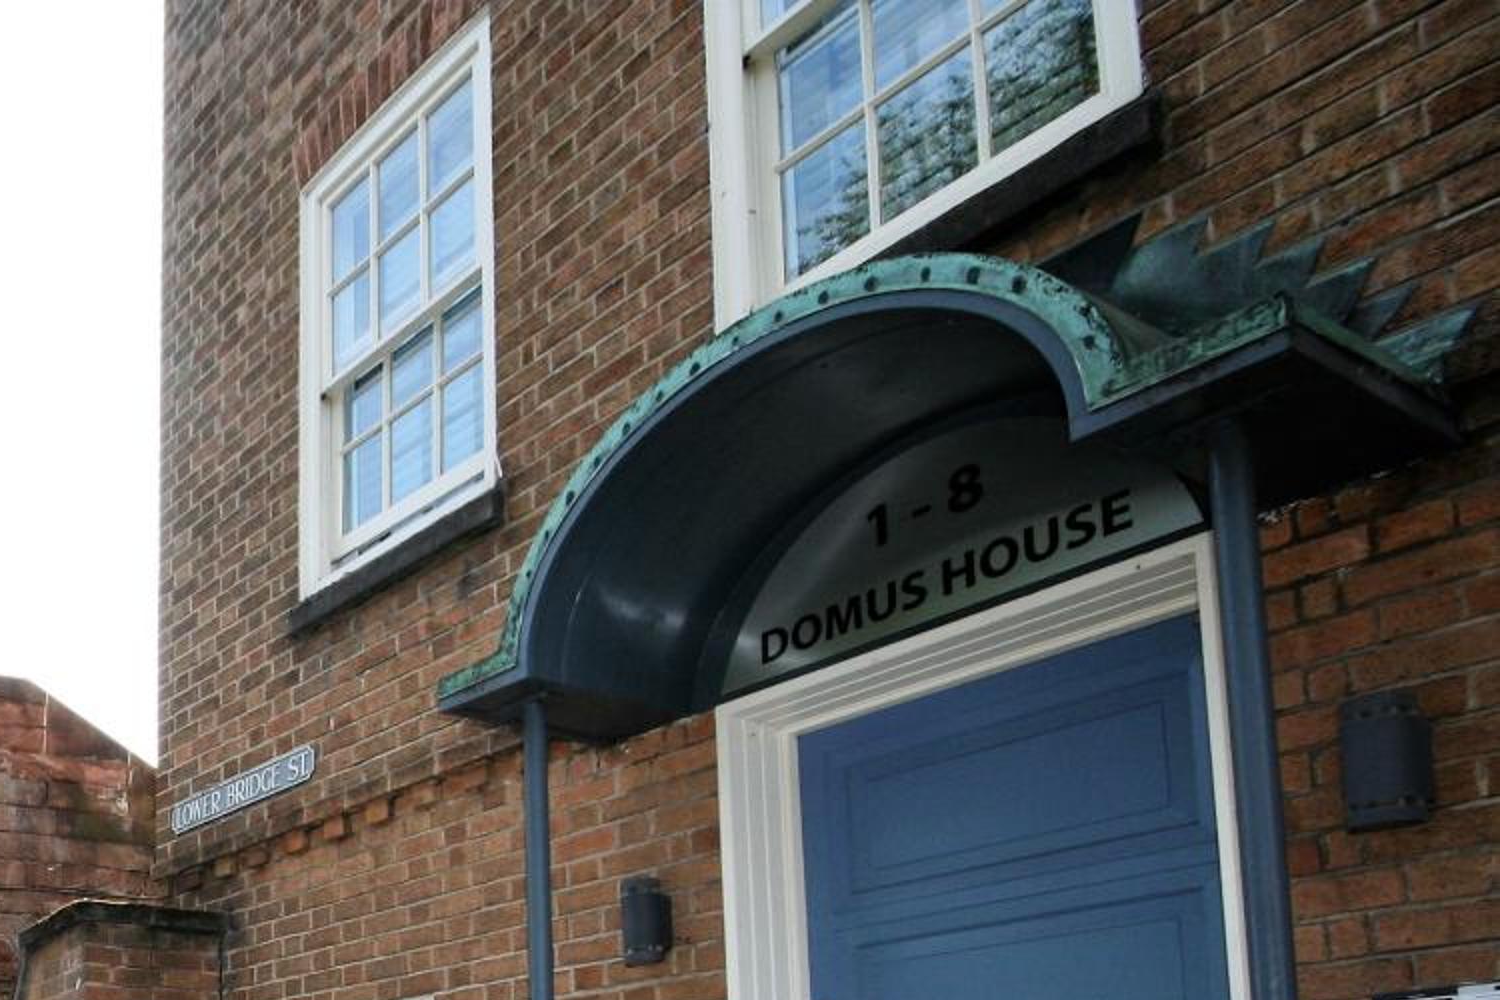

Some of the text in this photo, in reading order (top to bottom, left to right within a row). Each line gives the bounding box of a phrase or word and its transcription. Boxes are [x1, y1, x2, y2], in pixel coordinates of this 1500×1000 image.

[761, 489, 1133, 664] DOMUS HOUSE
[176, 791, 221, 828] LOWER
[227, 764, 281, 806] BRIDGE
